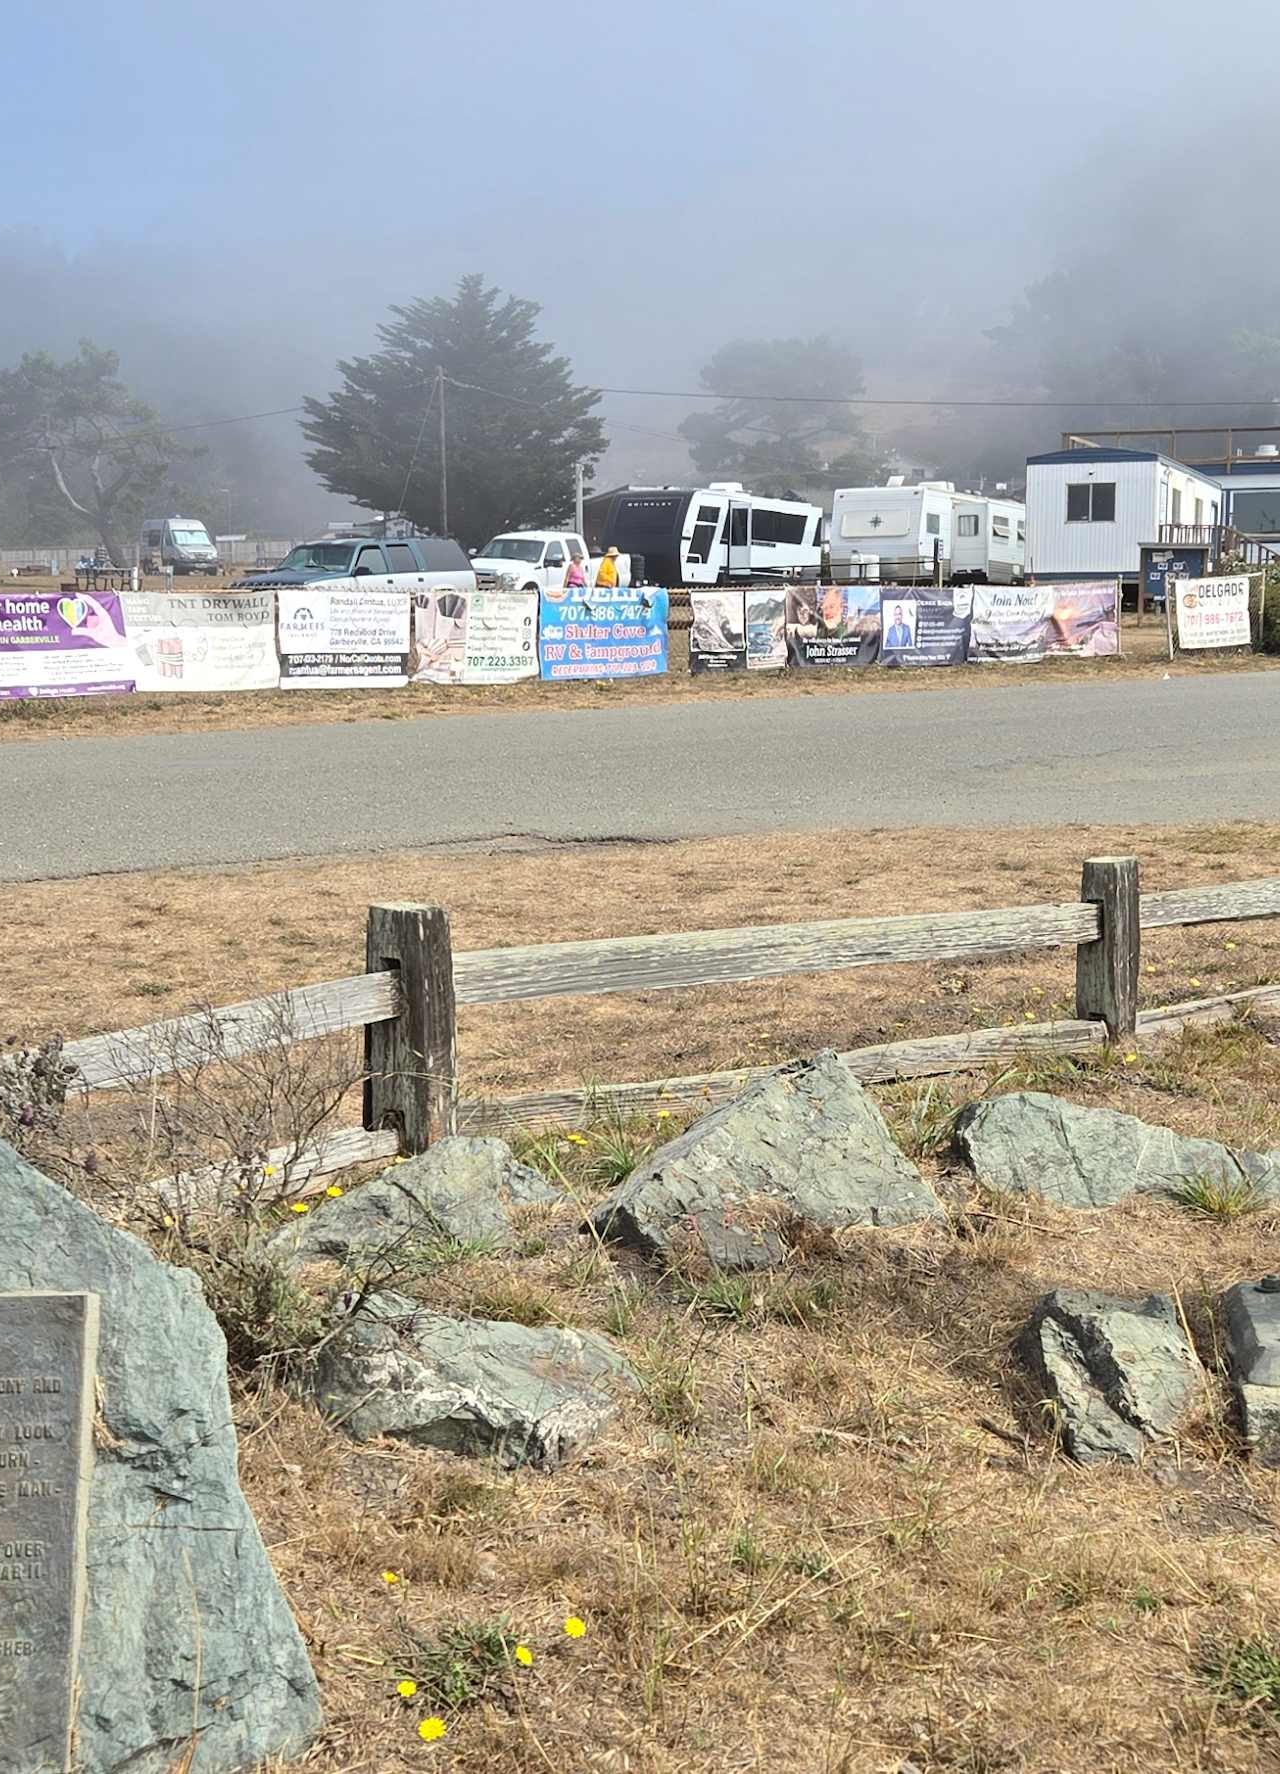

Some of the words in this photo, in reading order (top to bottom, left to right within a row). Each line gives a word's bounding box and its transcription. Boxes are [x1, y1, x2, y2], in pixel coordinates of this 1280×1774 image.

[5, 598, 50, 614] home
[169, 598, 199, 609] TNT
[202, 596, 269, 609] DRYWALL
[990, 593, 1012, 607] Join
[207, 612, 233, 622] TOM
[612, 623, 647, 639] Cove
[544, 644, 566, 661] RV
[568, 643, 583, 659] &
[806, 646, 827, 659] John
[827, 644, 858, 657] Strasser
[33, 1376, 62, 1394] AND
[4, 1542, 44, 1559] OVER
